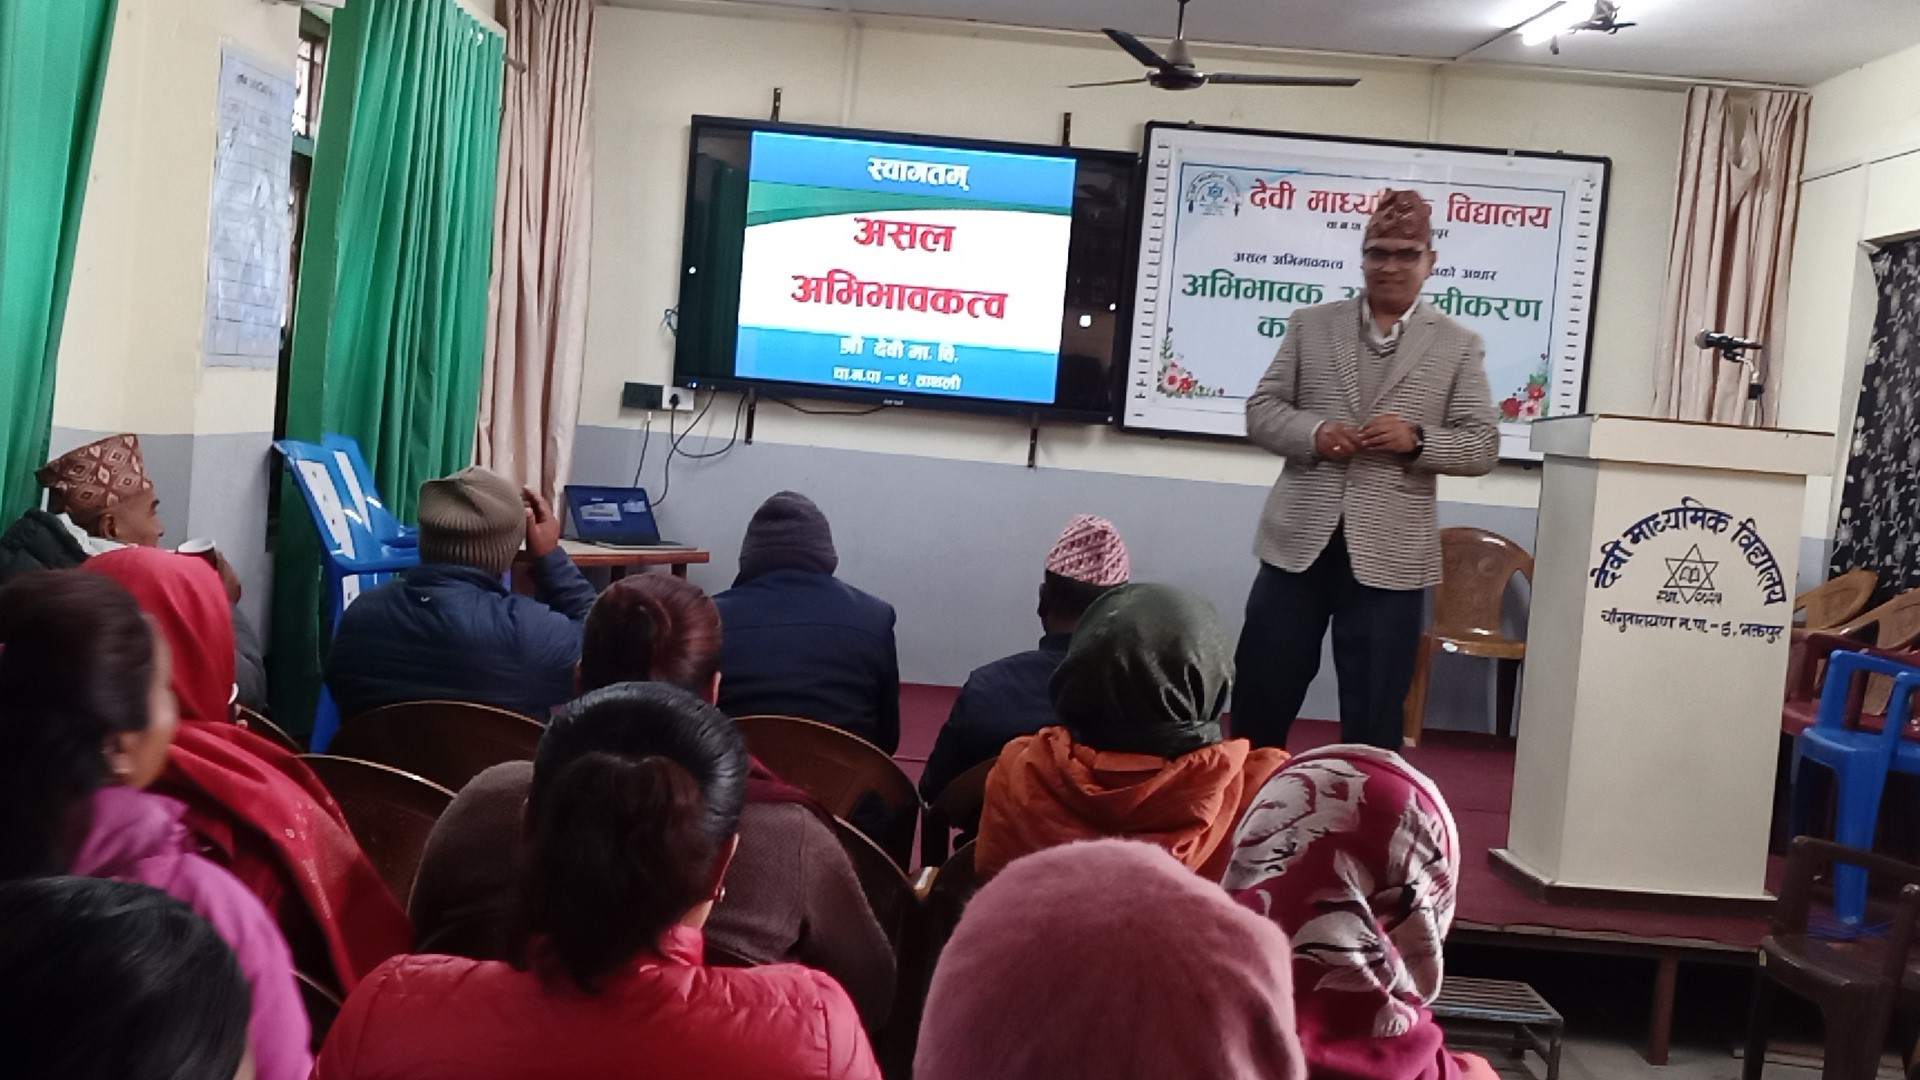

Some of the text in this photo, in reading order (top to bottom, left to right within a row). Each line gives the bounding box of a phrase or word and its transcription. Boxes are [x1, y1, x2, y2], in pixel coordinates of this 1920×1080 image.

[1250, 178, 1296, 210] देवी
[1447, 192, 1552, 229] विद्यालय
[854, 217, 956, 252] असल
[791, 268, 1008, 319] अभिभावकत्व
[1181, 268, 1324, 305] अभिभावक
[1590, 496, 1787, 606] देवी माध्यमिक विद्यालय
